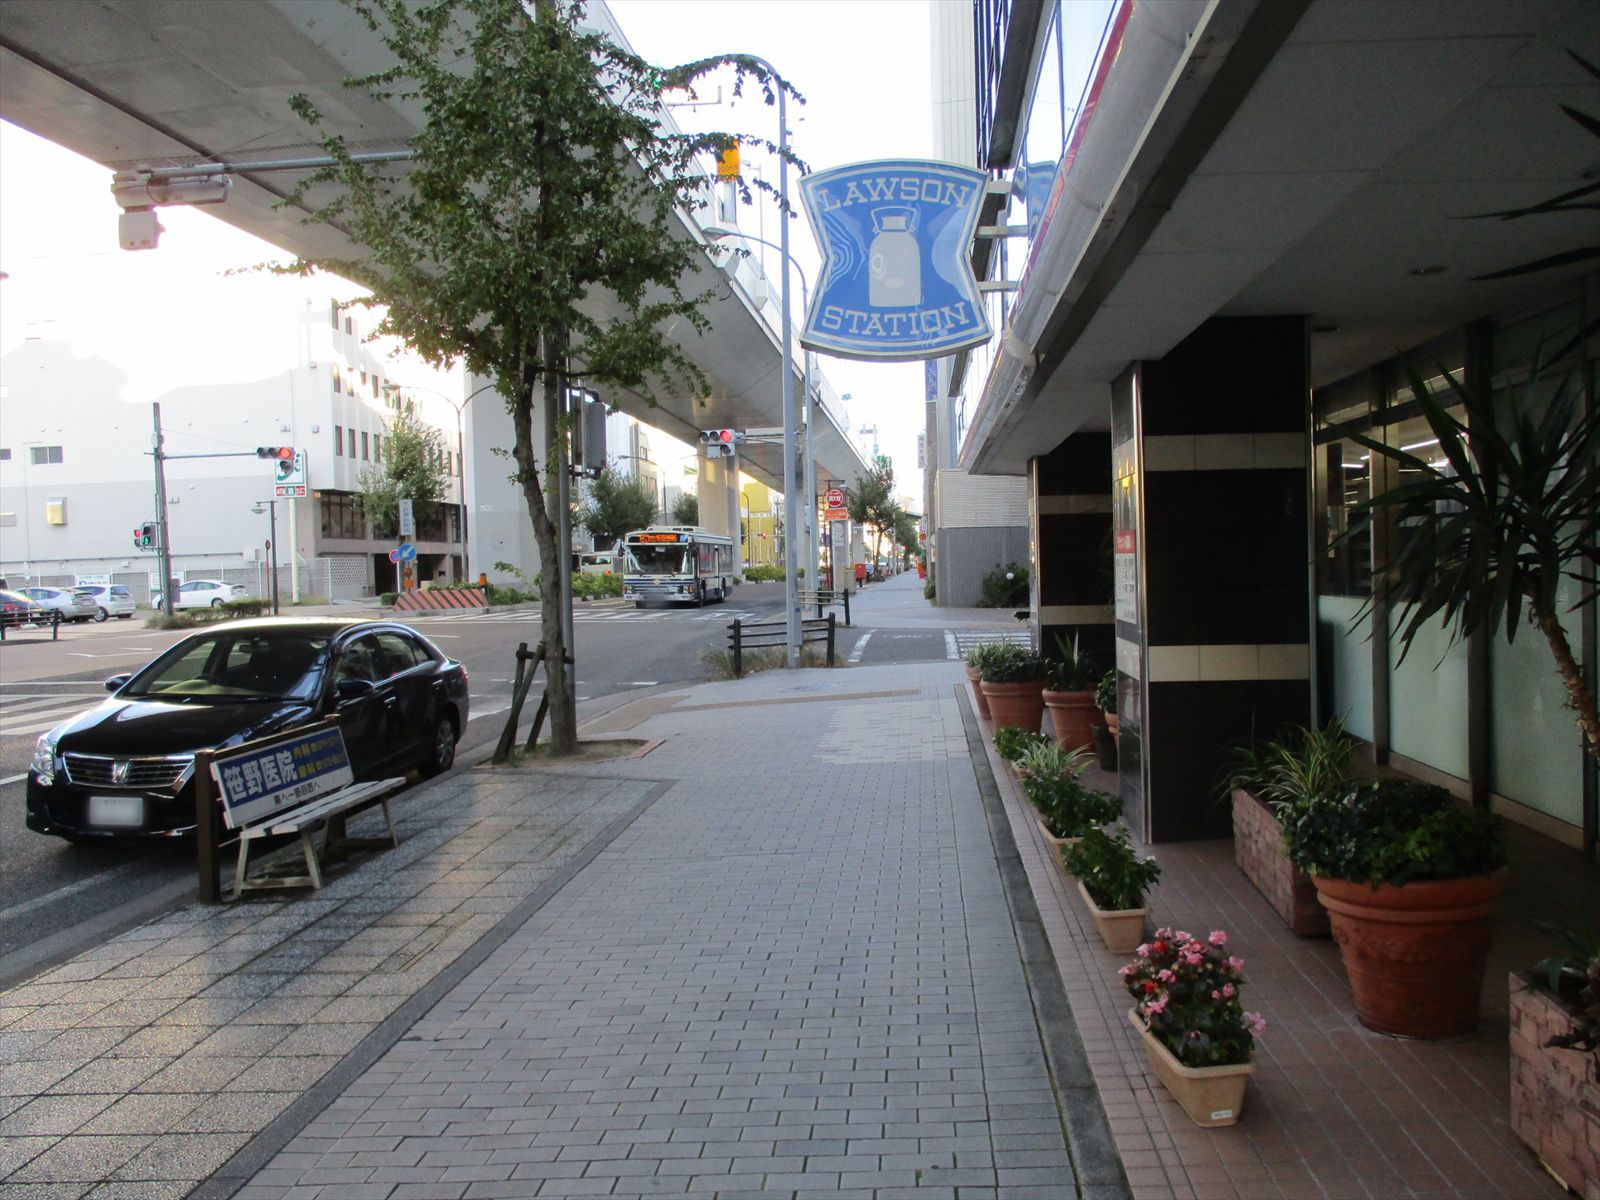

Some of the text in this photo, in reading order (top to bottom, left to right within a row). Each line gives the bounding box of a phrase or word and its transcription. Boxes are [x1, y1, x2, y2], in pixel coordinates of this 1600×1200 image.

[818, 177, 970, 212] LAWSON
[821, 302, 971, 336] STATION
[223, 750, 298, 802] 笹野医院
